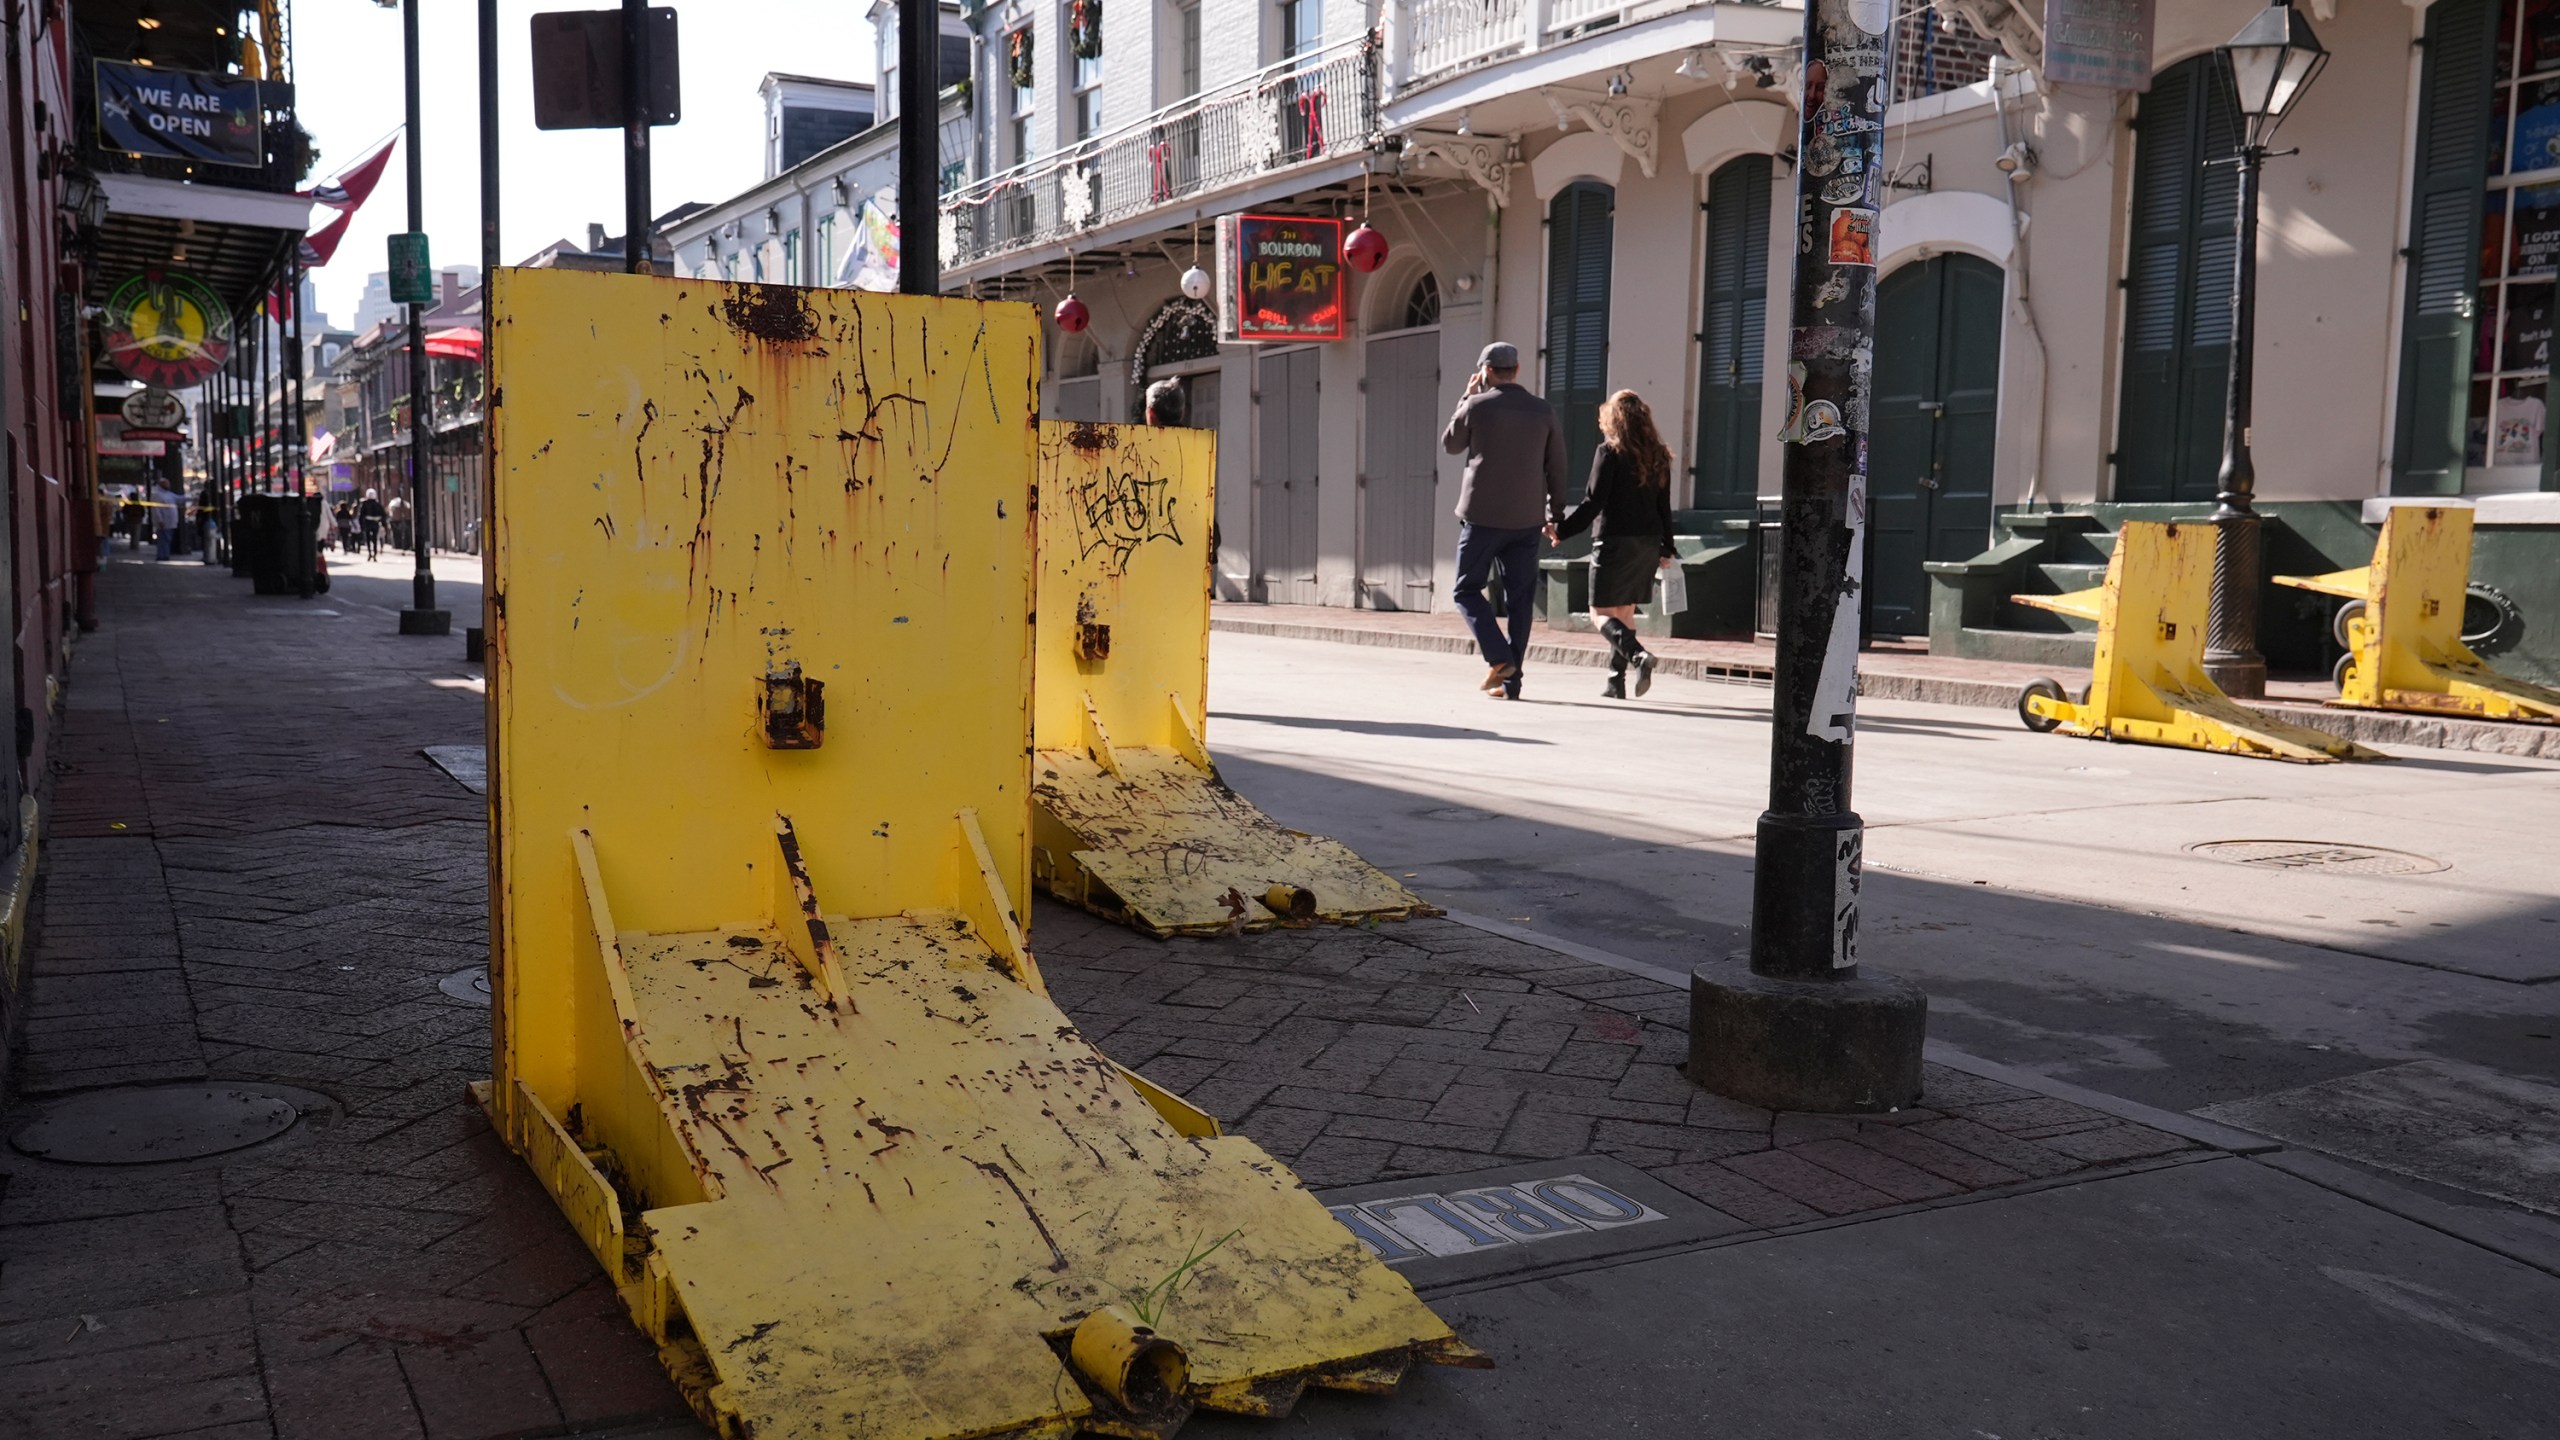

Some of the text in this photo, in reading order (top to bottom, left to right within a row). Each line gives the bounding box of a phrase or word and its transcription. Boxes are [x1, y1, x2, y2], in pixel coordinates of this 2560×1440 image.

[136, 86, 221, 113] WE ARE
[148, 113, 211, 137] OPEN
[1259, 241, 1322, 257] BOURBON
[1249, 262, 1336, 294] HEAT
[1258, 308, 1288, 325] GRILL
[1312, 304, 1337, 323] CLUB
